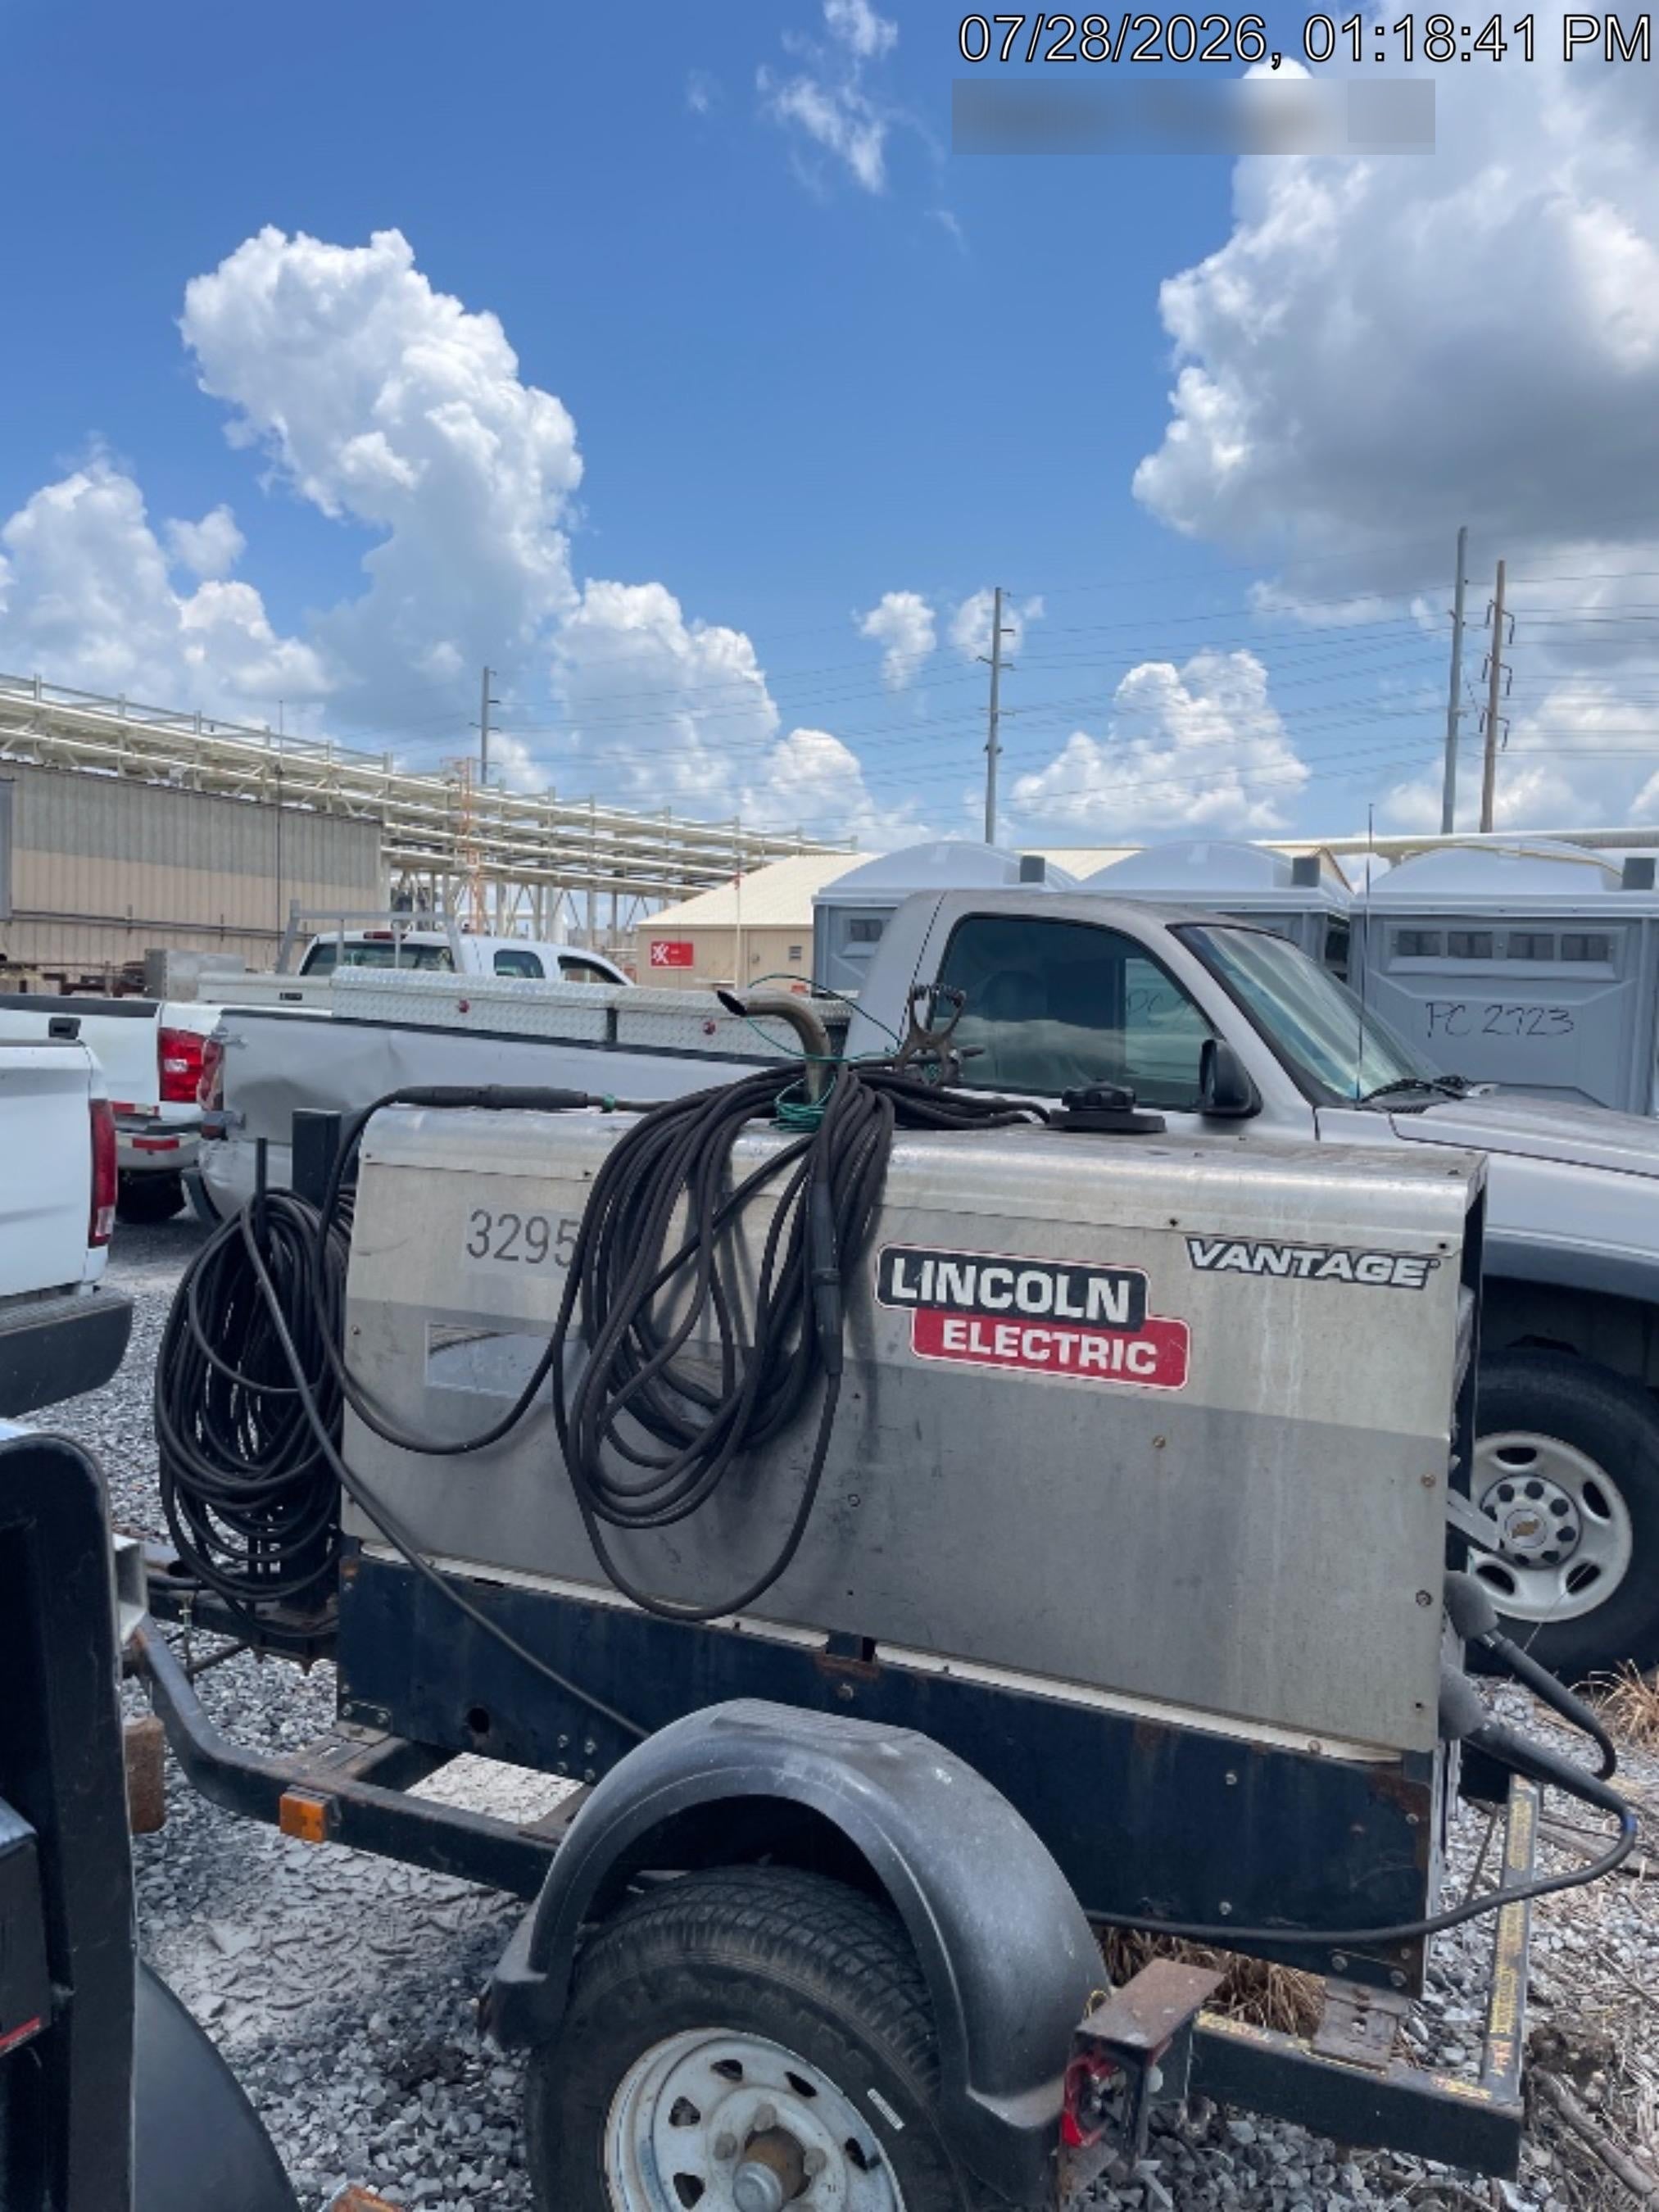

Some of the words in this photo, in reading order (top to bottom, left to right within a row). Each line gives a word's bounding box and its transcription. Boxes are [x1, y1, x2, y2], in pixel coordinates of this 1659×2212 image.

[1426, 1002, 1470, 1038] PC
[1482, 1004, 1574, 1036] 2723
[891, 1257, 1131, 1324] LINCOLN
[1185, 1238, 1429, 1290] VANTAGE
[942, 1318, 1158, 1375] ELECTRIC
